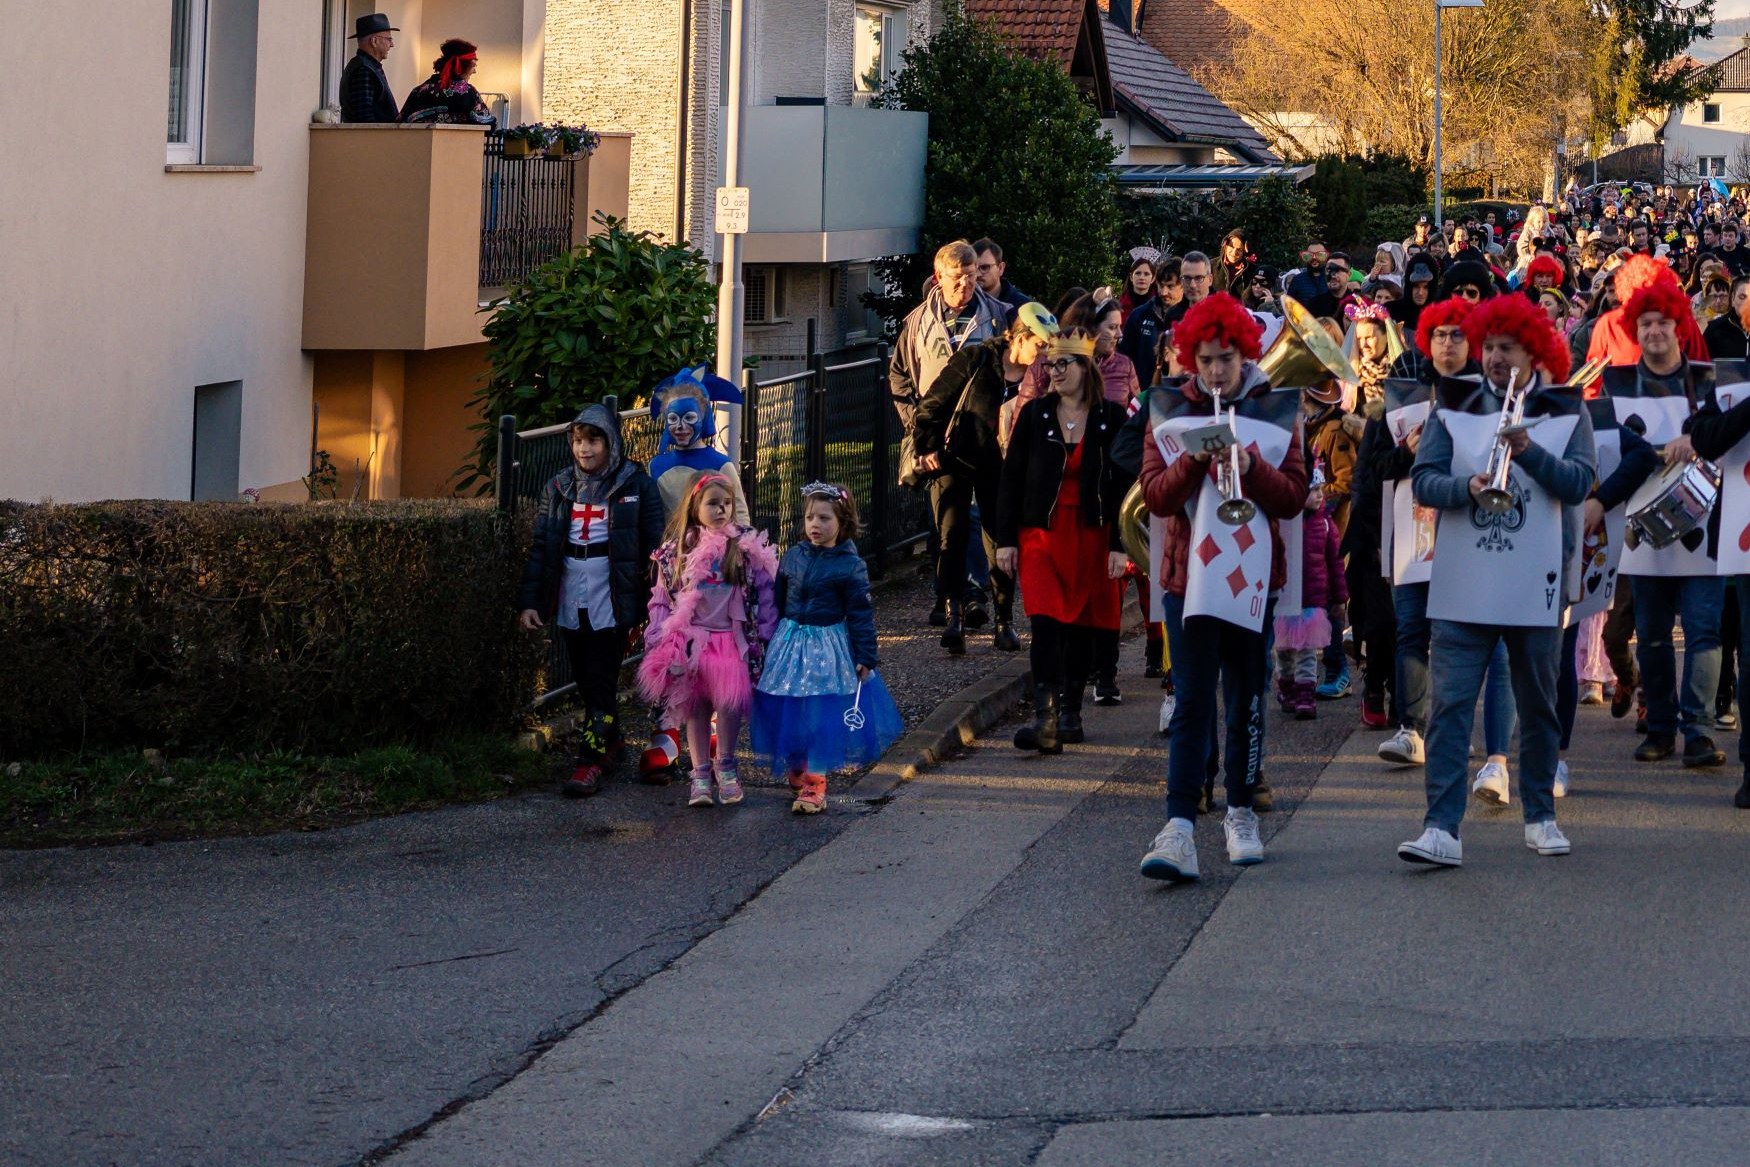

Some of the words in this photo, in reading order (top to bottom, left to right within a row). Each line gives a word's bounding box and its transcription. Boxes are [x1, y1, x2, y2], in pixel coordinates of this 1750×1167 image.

[1160, 433, 1180, 457] 10
[1544, 587, 1556, 611] A
[1604, 581, 1613, 600] Q
[1250, 594, 1263, 619] 10
